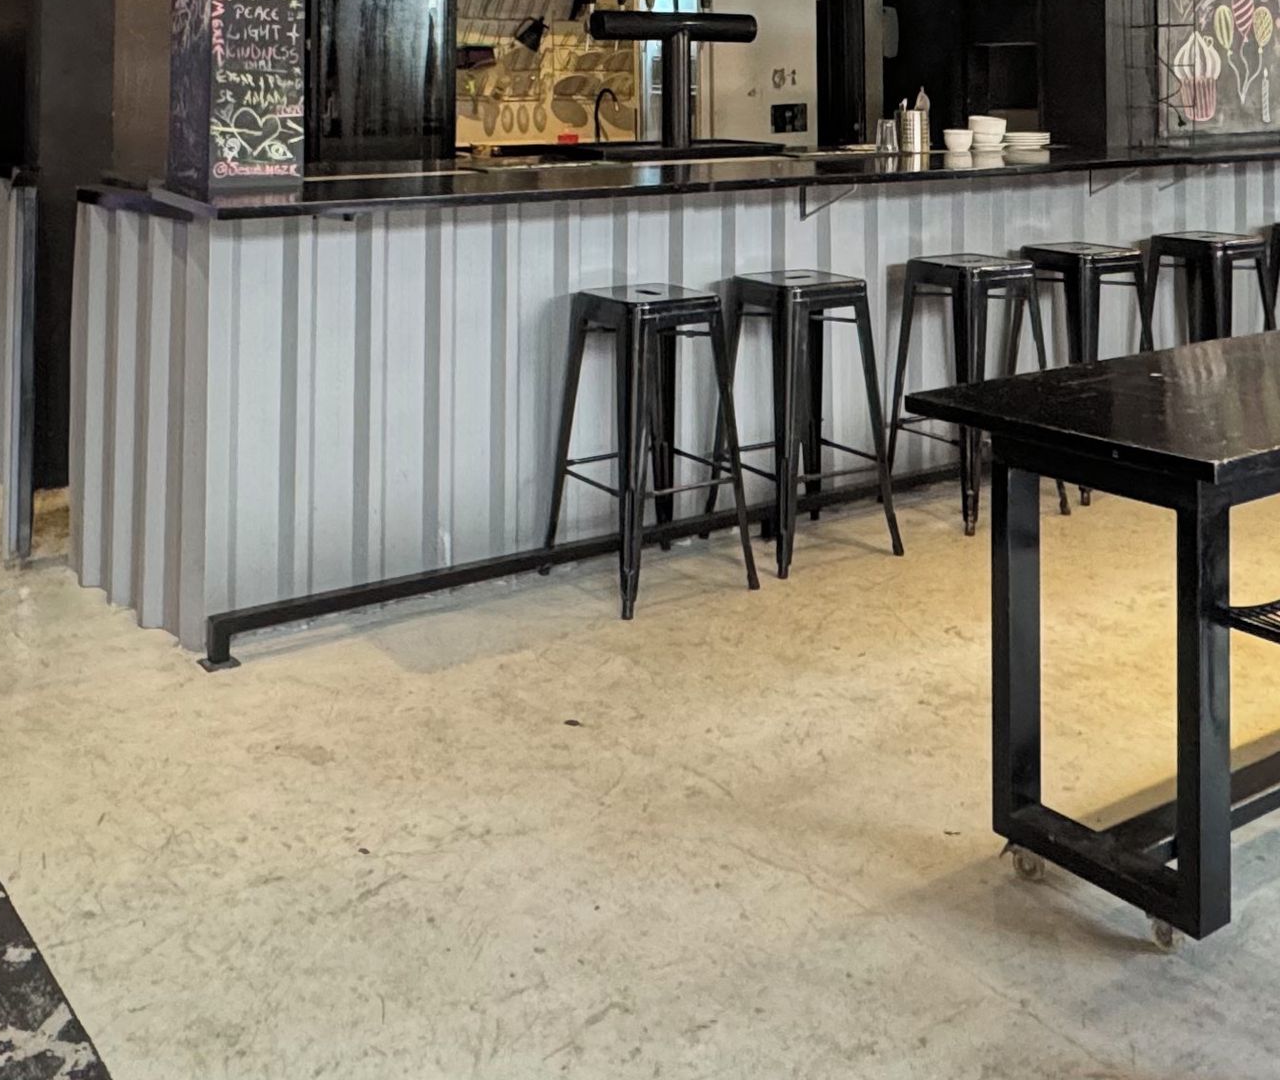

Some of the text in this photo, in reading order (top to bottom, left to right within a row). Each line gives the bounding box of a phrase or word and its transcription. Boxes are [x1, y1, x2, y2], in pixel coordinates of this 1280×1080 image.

[234, 3, 280, 21] PEACE
[226, 23, 282, 41] LIGHT
[225, 40, 300, 64] KINDNESS
